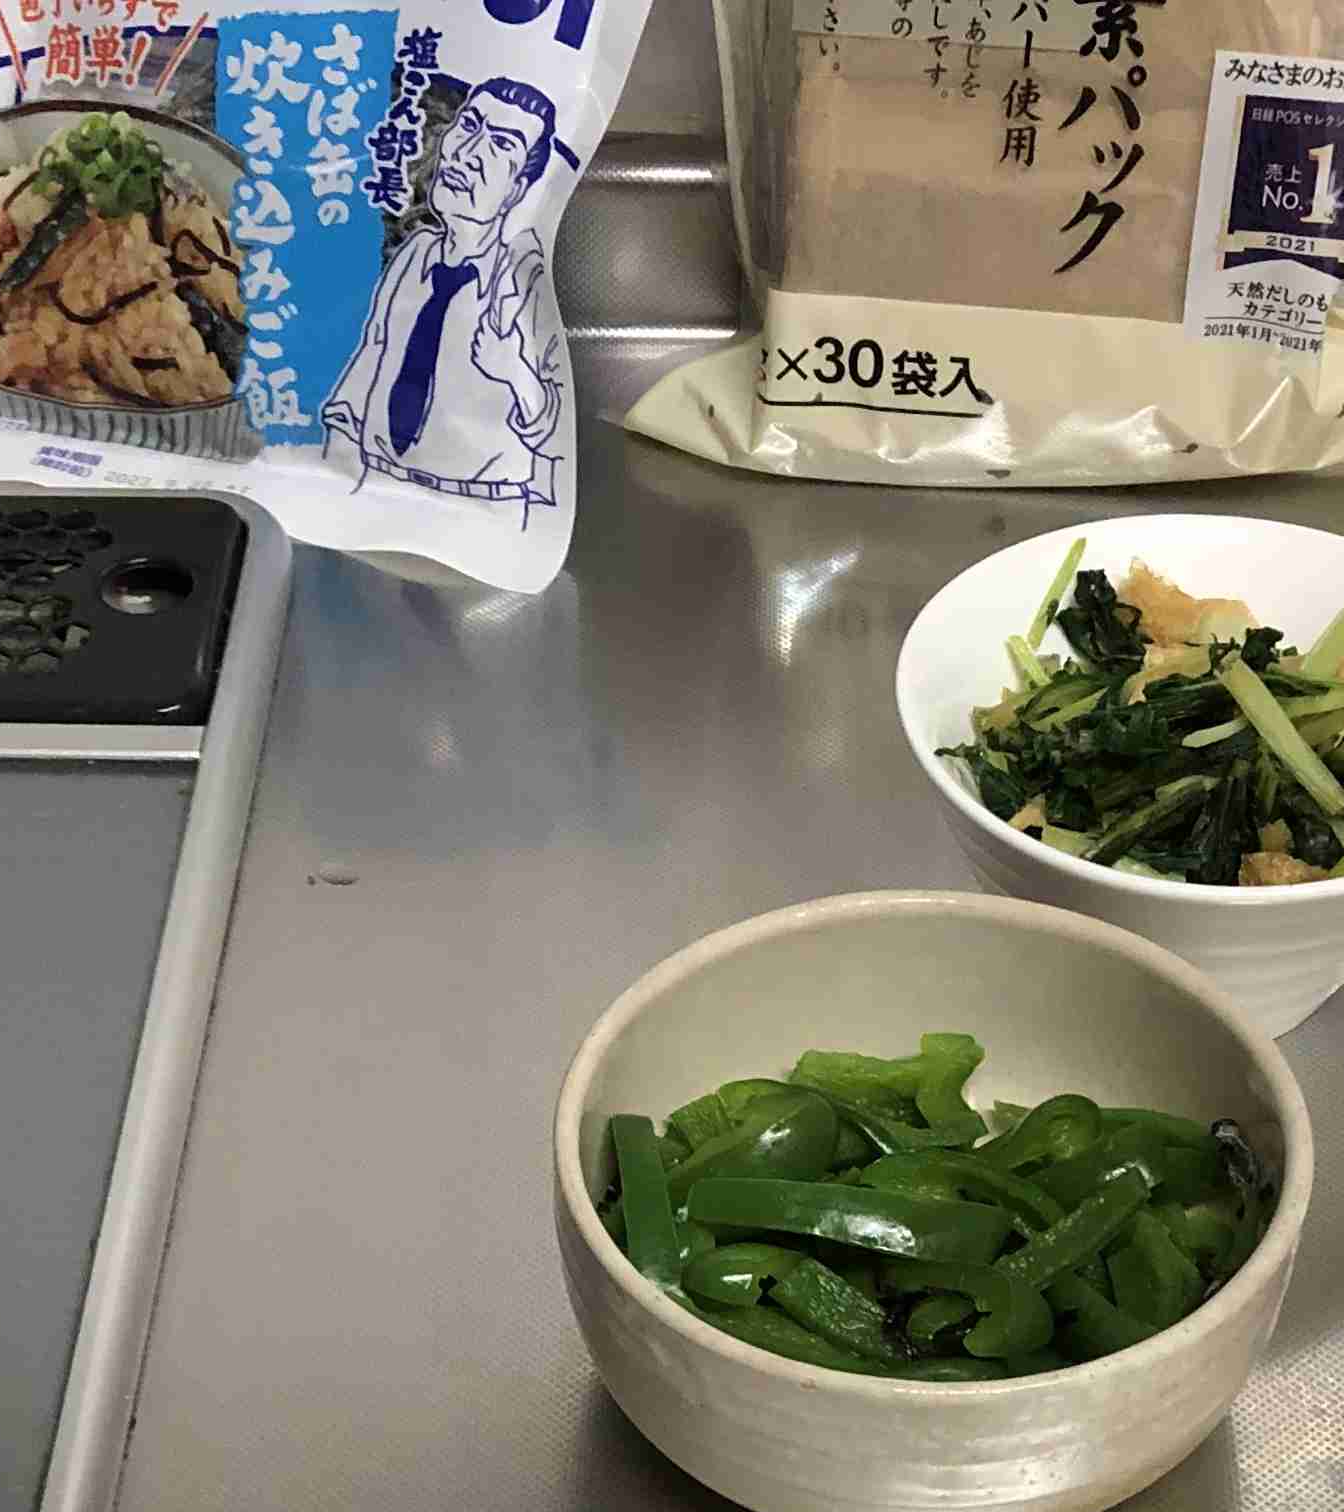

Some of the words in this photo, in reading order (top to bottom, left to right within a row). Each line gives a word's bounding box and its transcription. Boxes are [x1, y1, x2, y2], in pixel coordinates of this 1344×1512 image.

[45, 23, 148, 86] 簡単!
[923, 0, 951, 99] しです。
[306, 23, 378, 226] さば缶の
[362, 25, 443, 212] 塩こん部長
[1263, 163, 1303, 184] 売上
[223, 30, 313, 430] 炊き込みご飯
[1265, 234, 1316, 252] 2021
[1242, 301, 1324, 327] カテゴリー
